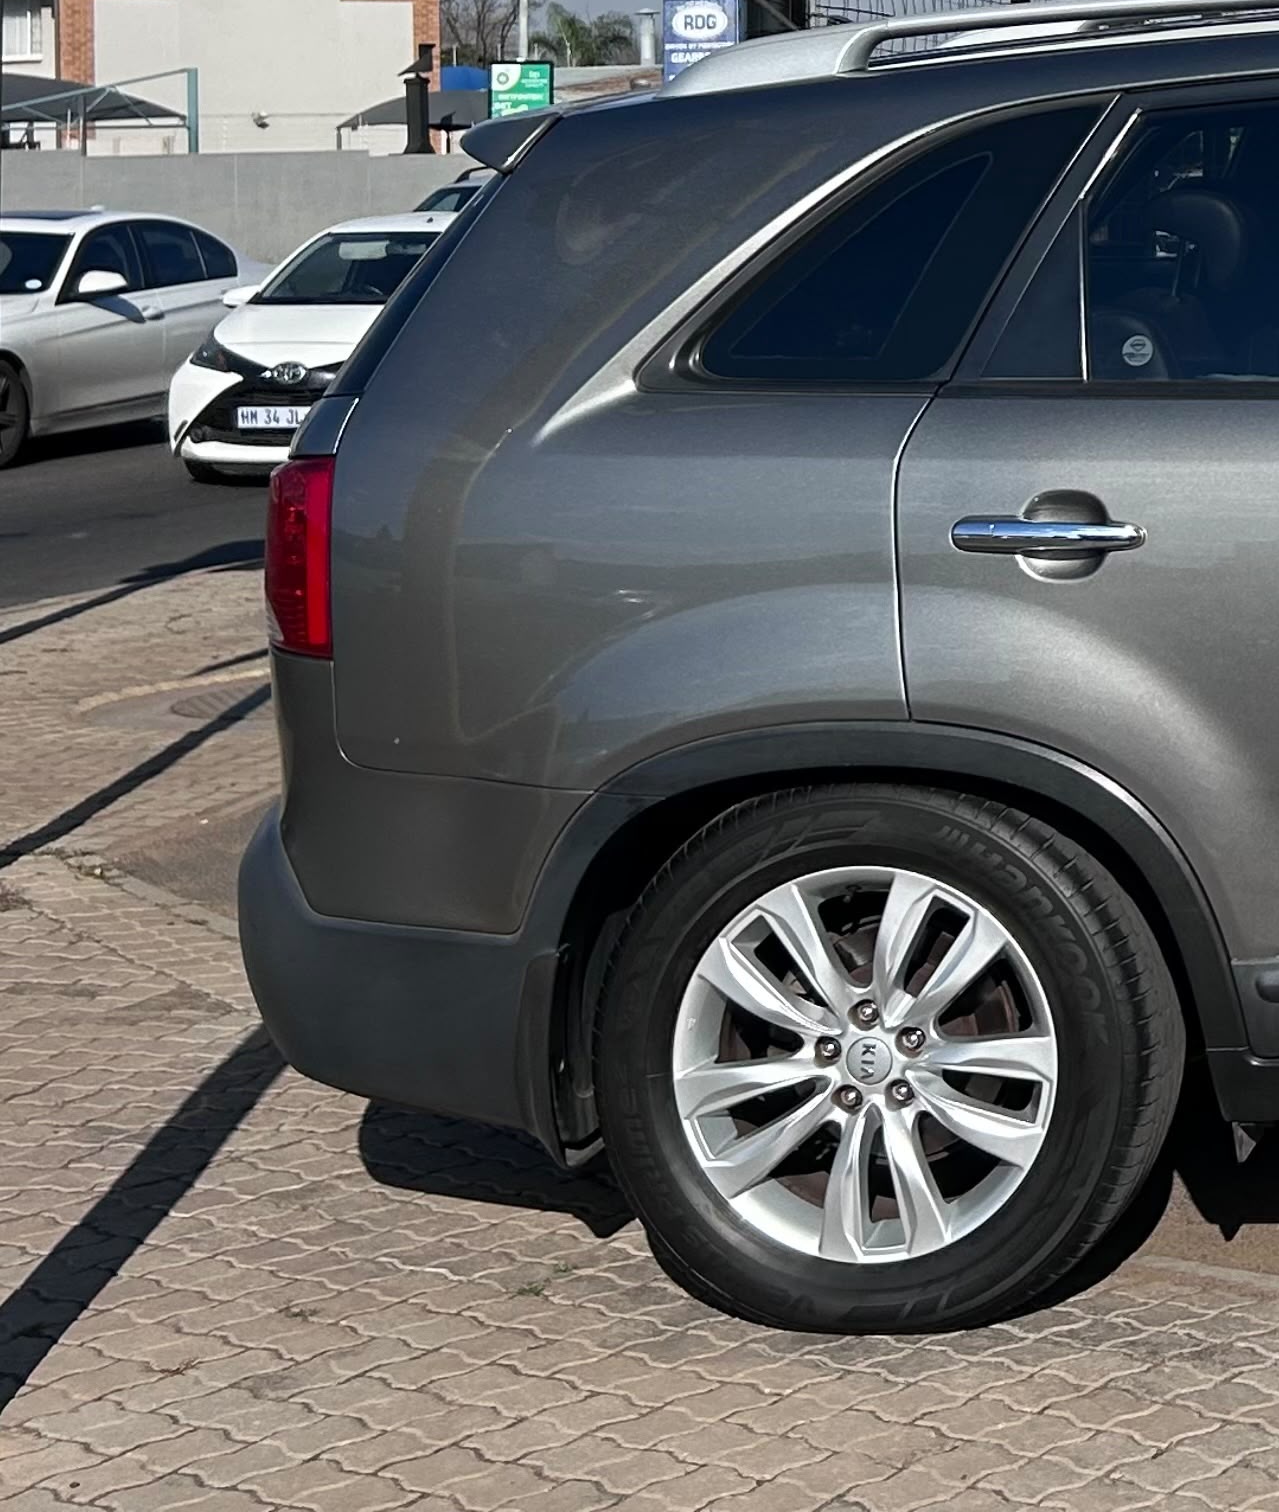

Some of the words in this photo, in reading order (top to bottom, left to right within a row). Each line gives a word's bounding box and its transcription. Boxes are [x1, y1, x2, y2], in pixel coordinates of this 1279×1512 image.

[683, 14, 718, 30] RDG
[264, 408, 280, 425] 34
[861, 1043, 877, 1080] KIA
